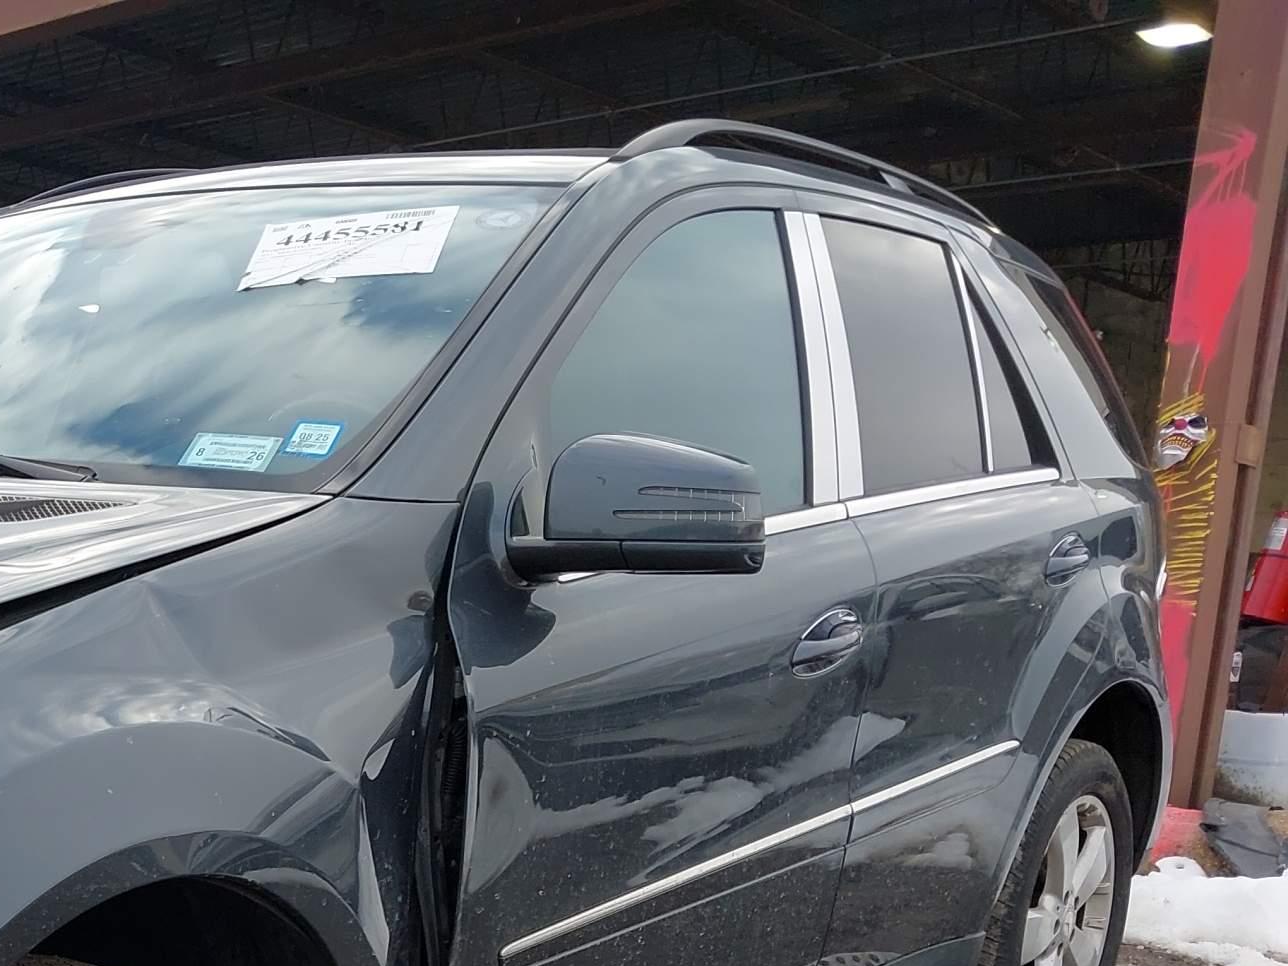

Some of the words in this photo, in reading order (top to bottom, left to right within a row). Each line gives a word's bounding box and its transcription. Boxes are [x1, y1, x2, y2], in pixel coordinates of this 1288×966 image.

[276, 219, 424, 246] 44455581
[298, 432, 313, 441] 08
[315, 433, 329, 442] 25
[195, 447, 206, 457] 8
[247, 451, 266, 461] 26
